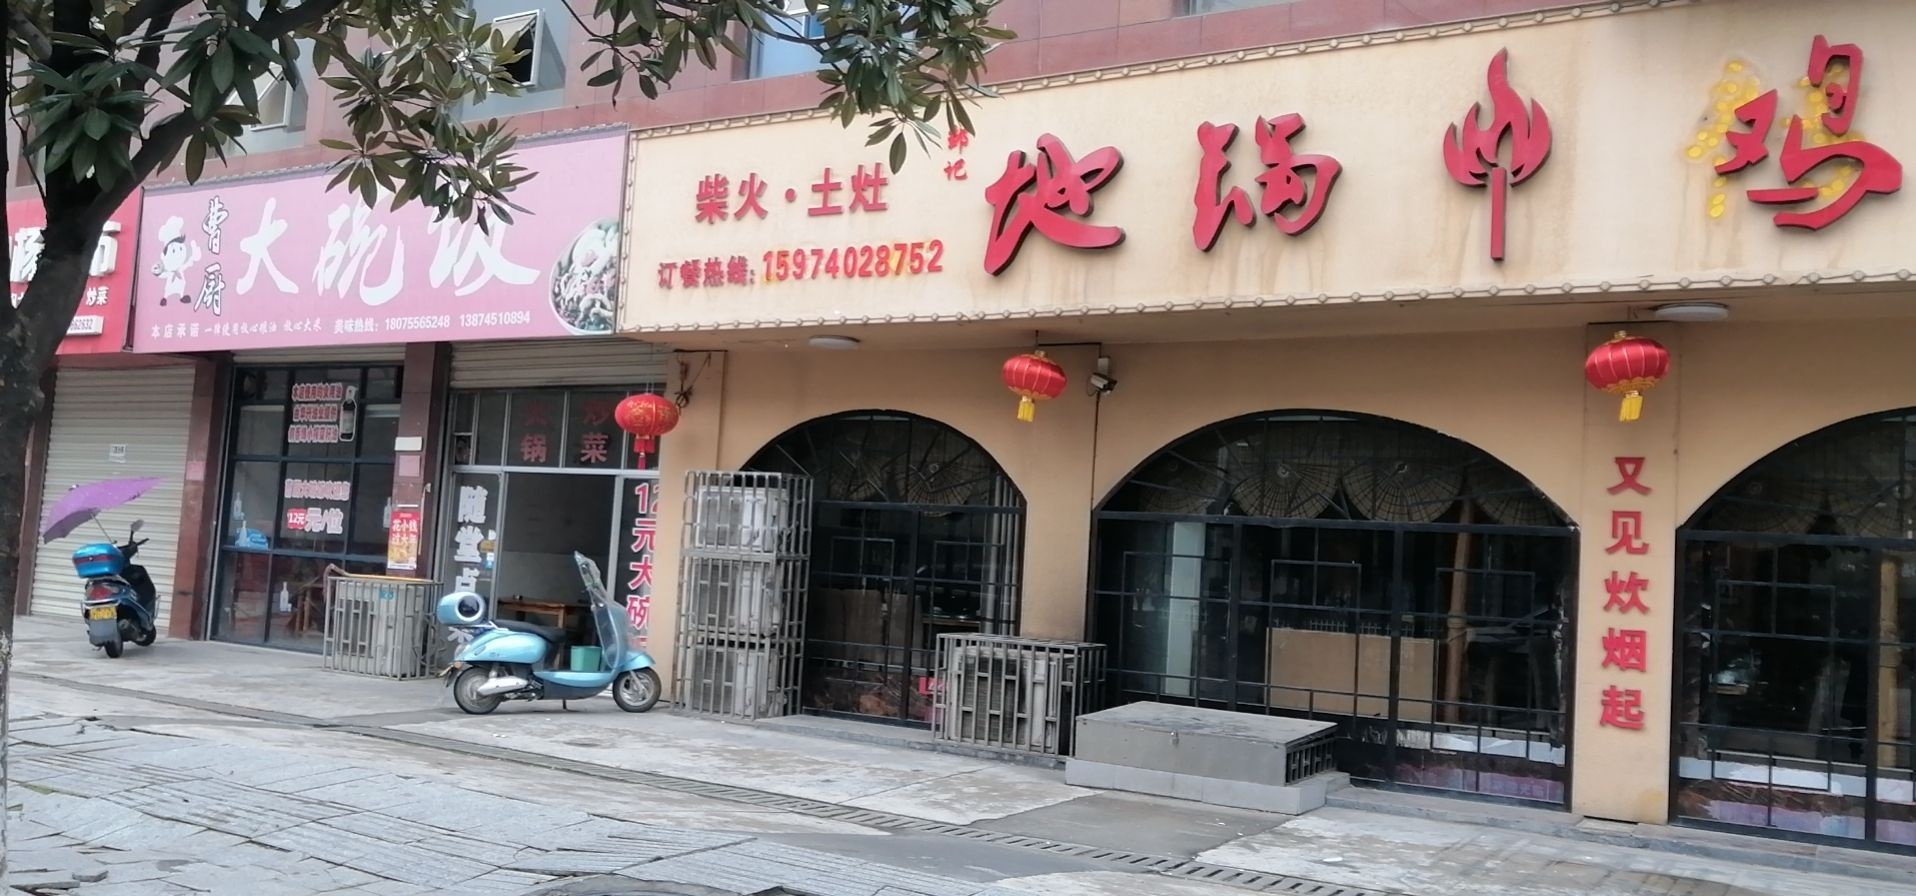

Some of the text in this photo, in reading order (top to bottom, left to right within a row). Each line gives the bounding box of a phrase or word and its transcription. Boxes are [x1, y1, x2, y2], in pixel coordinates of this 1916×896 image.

[762, 239, 944, 283] 15974028752
[385, 315, 450, 331] 18075565248
[459, 310, 531, 328] 13874510894
[1599, 456, 1652, 732] 又见炊烟起
